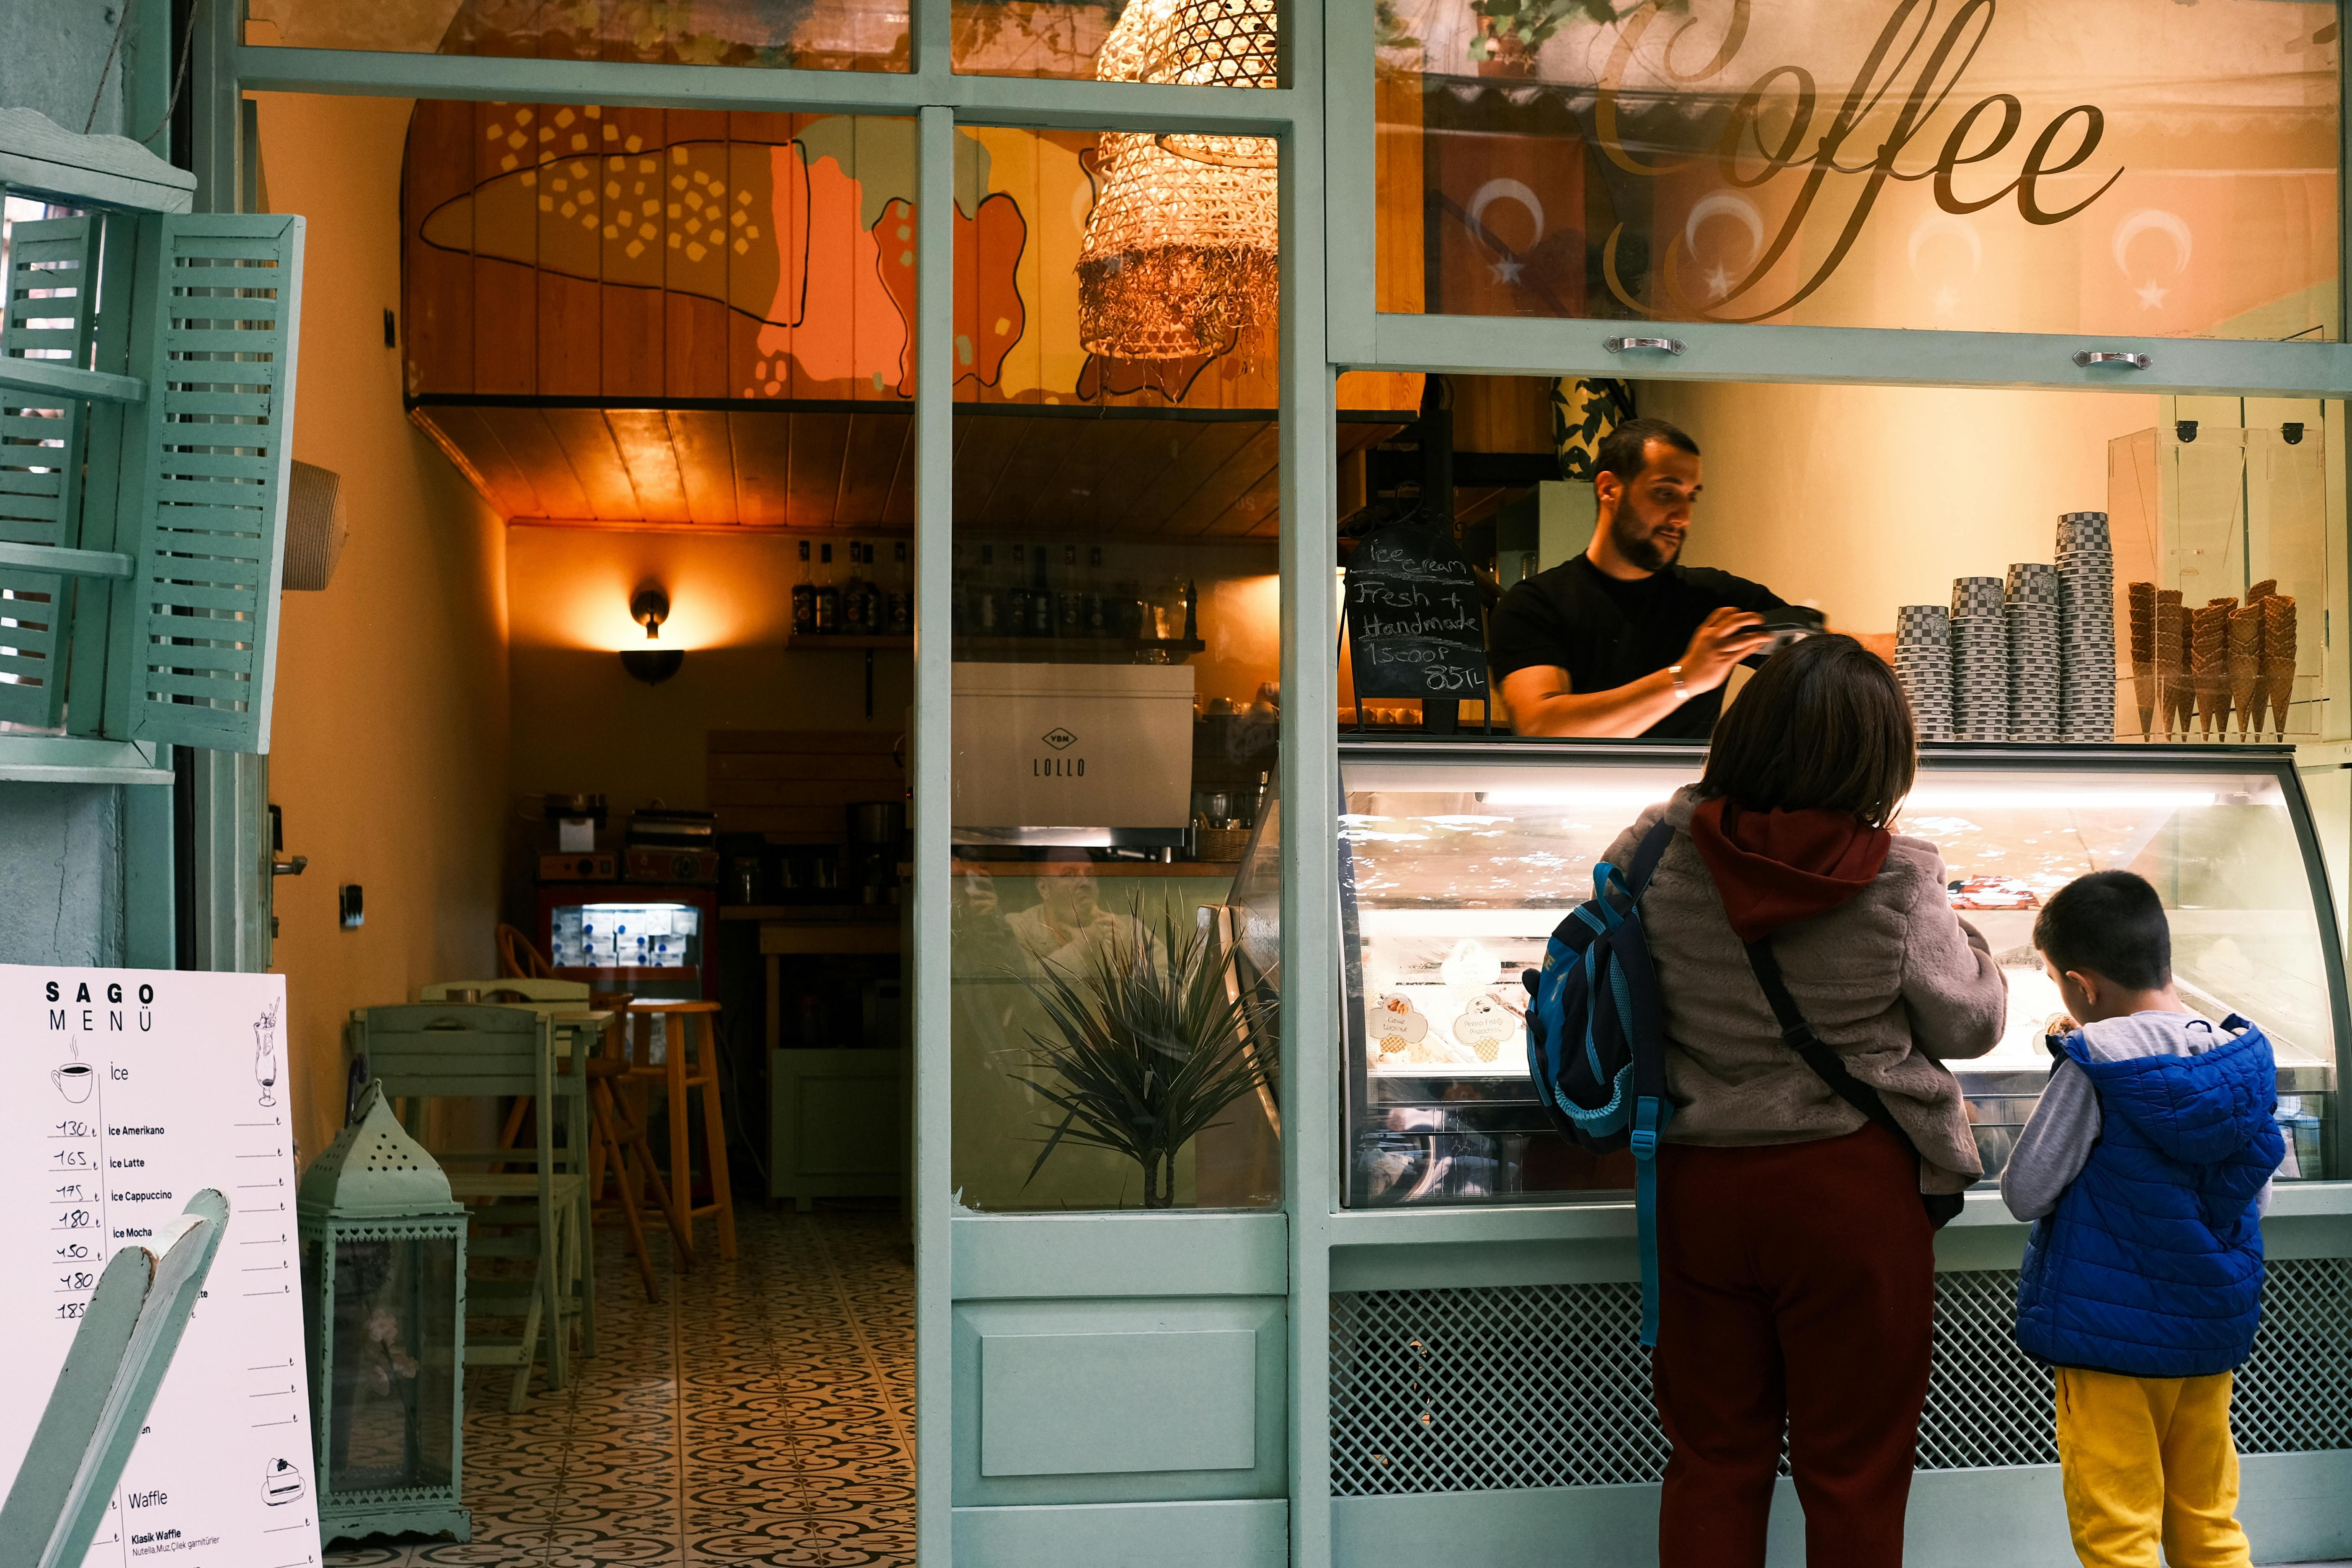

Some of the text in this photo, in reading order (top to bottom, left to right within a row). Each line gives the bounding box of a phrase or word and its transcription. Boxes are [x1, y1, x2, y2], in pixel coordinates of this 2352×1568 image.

[1595, 0, 2125, 323] Coffee
[1354, 581, 1430, 607] Fresh
[1363, 606, 1479, 636] Handmade
[1034, 759, 1084, 776] LOLLO
[46, 981, 153, 1004] SAGO
[50, 1006, 150, 1032] MENÜ
[56, 1121, 87, 1137] 130
[122, 1126, 164, 1135] Amerikano
[54, 1150, 86, 1165] 165
[124, 1159, 144, 1167] Latte
[56, 1185, 83, 1201] 175
[125, 1190, 172, 1202] Cappuccino
[59, 1210, 89, 1228] 180
[127, 1228, 152, 1237] Mocha
[60, 1272, 93, 1289] 180
[57, 1303, 85, 1319] 185
[129, 1491, 167, 1509] Waffle
[132, 1529, 181, 1545] Klasik Waffle
